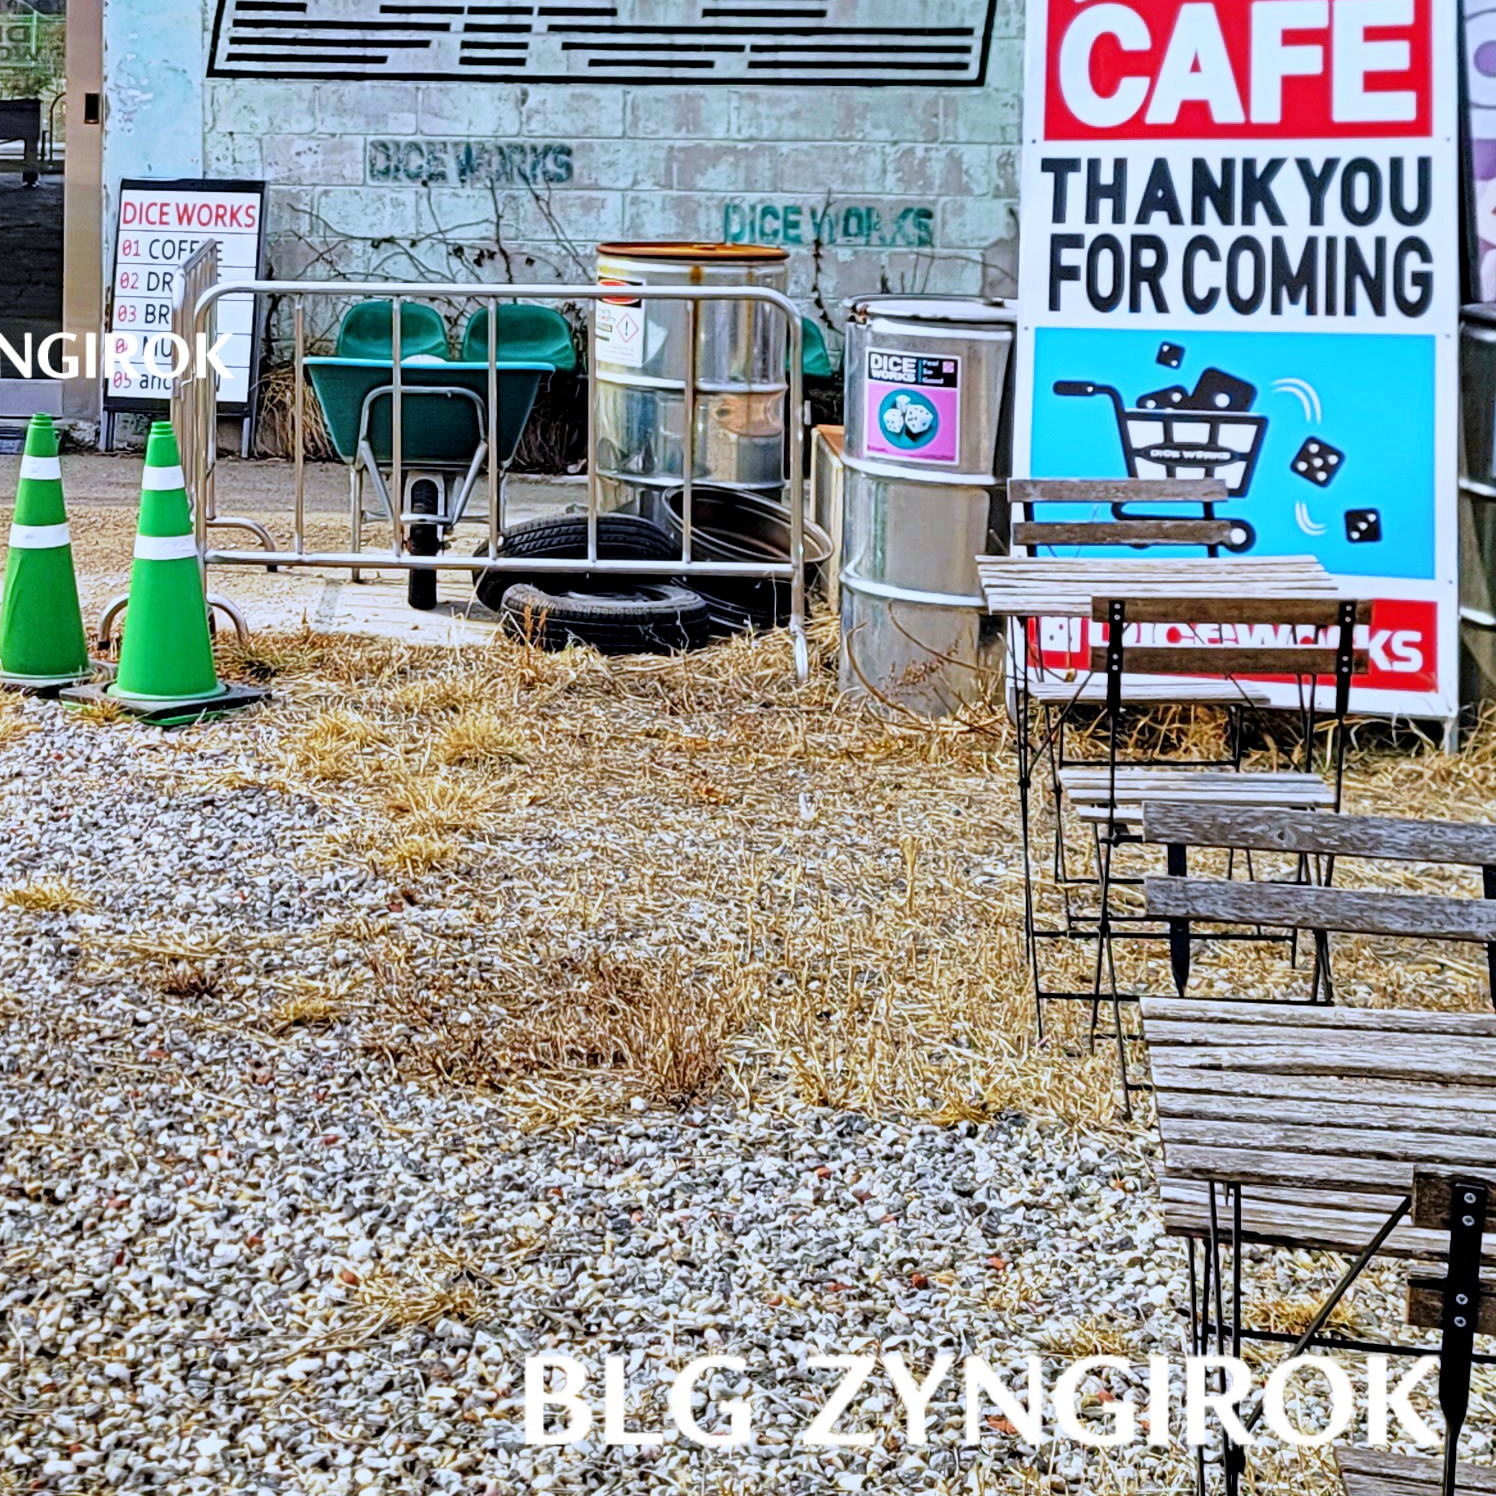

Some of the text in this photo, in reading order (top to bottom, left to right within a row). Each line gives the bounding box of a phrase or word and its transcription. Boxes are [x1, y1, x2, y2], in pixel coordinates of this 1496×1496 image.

[1040, 156, 1433, 227] THANK YOU
[122, 201, 257, 229] DICE WORKS
[724, 203, 803, 245] DICE
[1048, 232, 1434, 319] FOR COMING
[870, 353, 917, 374] DICE
[871, 370, 916, 383] WORKS
